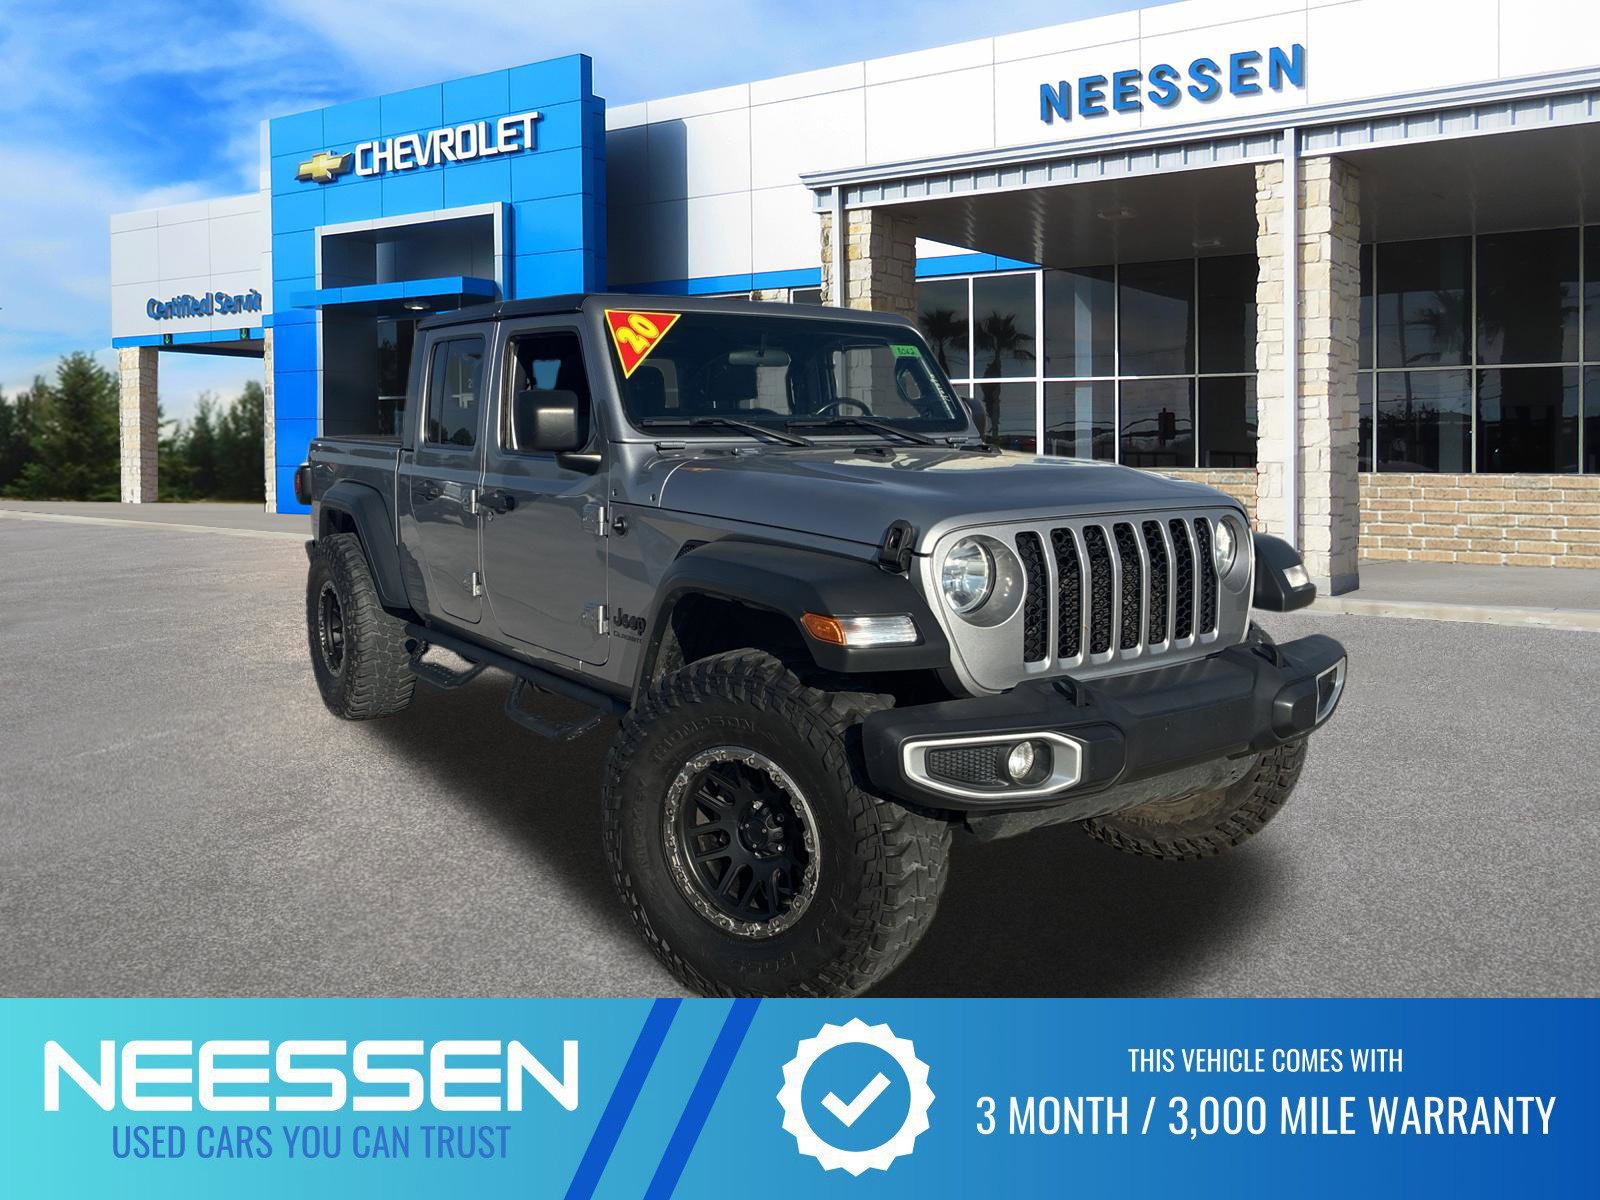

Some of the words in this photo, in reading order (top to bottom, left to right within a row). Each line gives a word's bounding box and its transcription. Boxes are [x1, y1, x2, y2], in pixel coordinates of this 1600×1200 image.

[1039, 43, 1306, 125] NEESSEN
[354, 110, 543, 178] CHEVROLET
[146, 291, 214, 321] Certified
[615, 313, 660, 355] 20
[612, 607, 647, 637] Jeep
